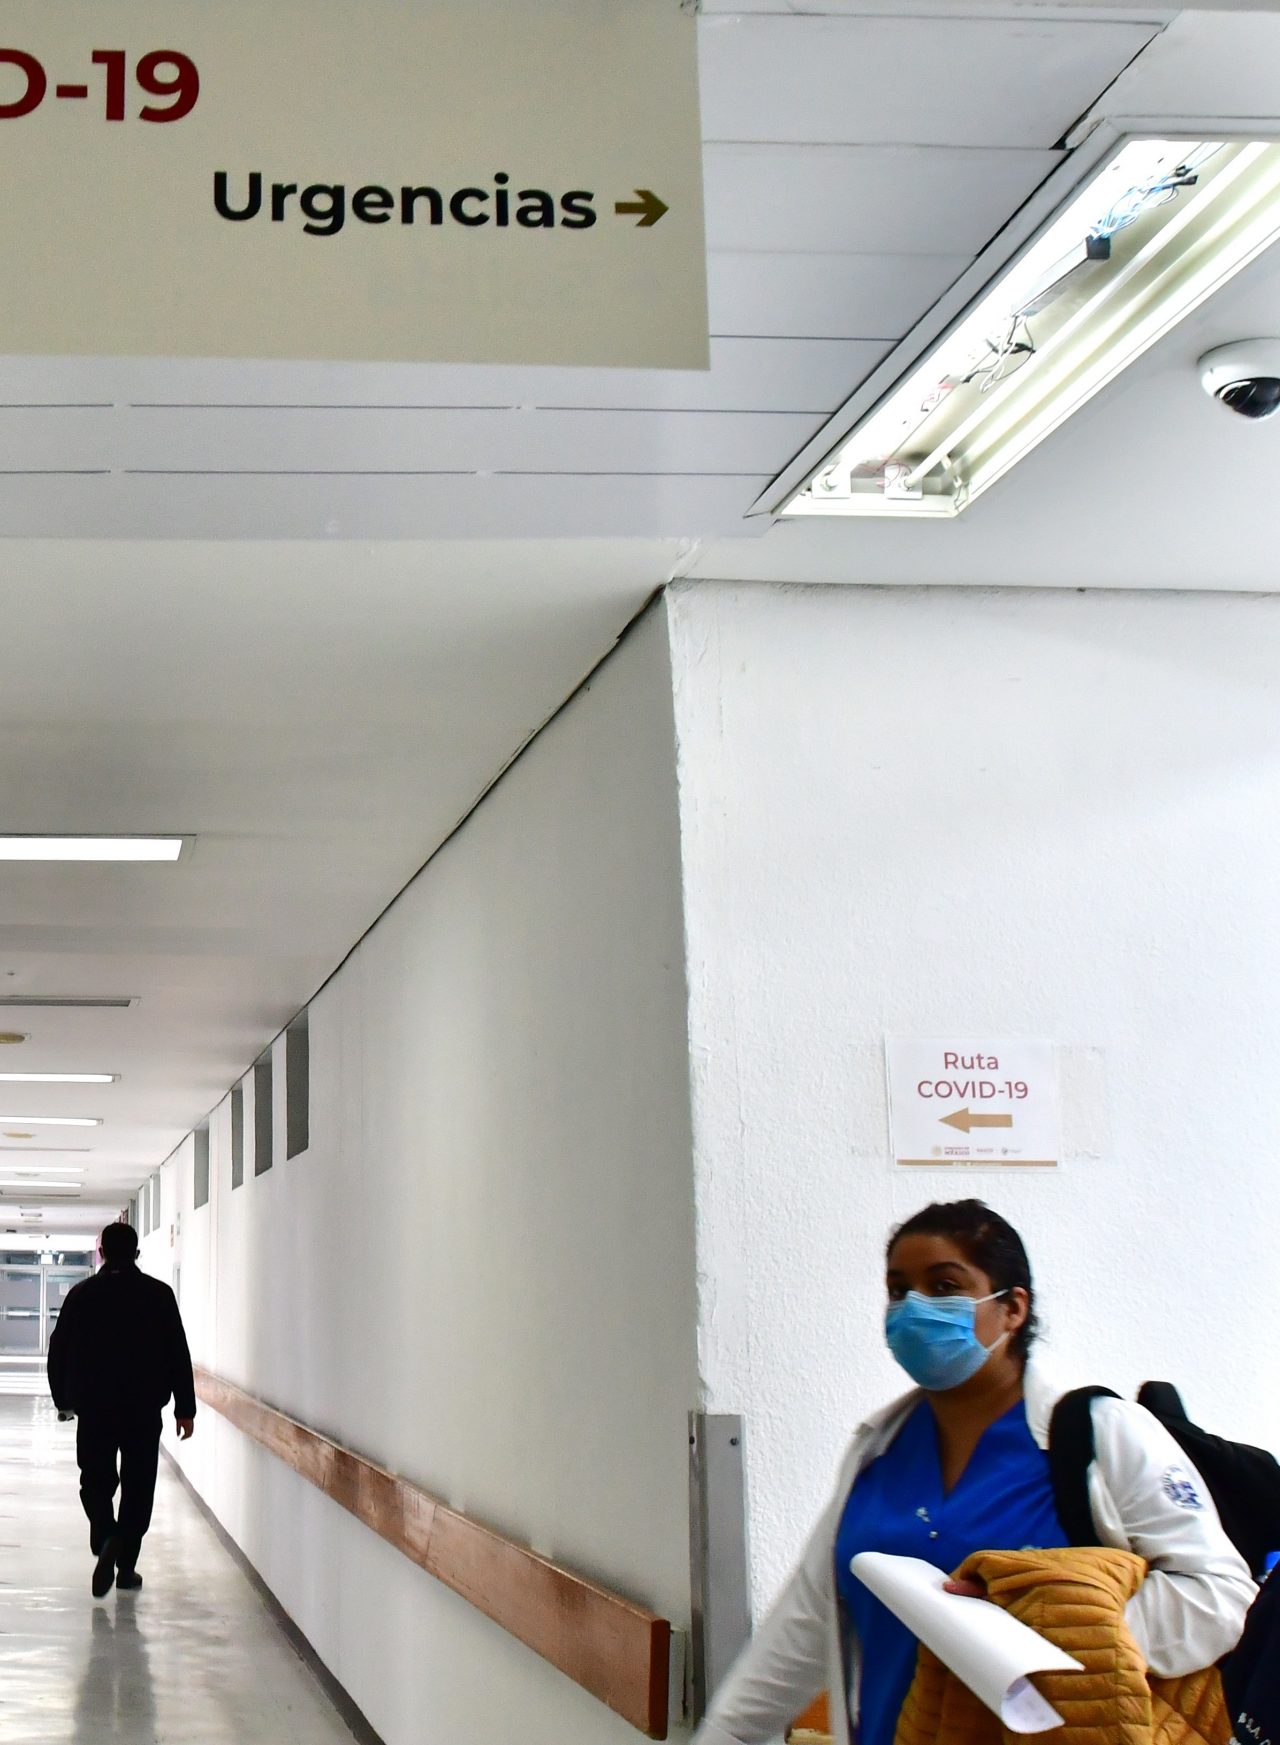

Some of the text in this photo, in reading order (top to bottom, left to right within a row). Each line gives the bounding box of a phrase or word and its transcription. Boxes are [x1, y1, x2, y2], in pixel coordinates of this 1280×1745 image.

[213, 171, 598, 237] Urgencias
[943, 1051, 1000, 1071] Ruta
[917, 1080, 1029, 1100] COVID-19
